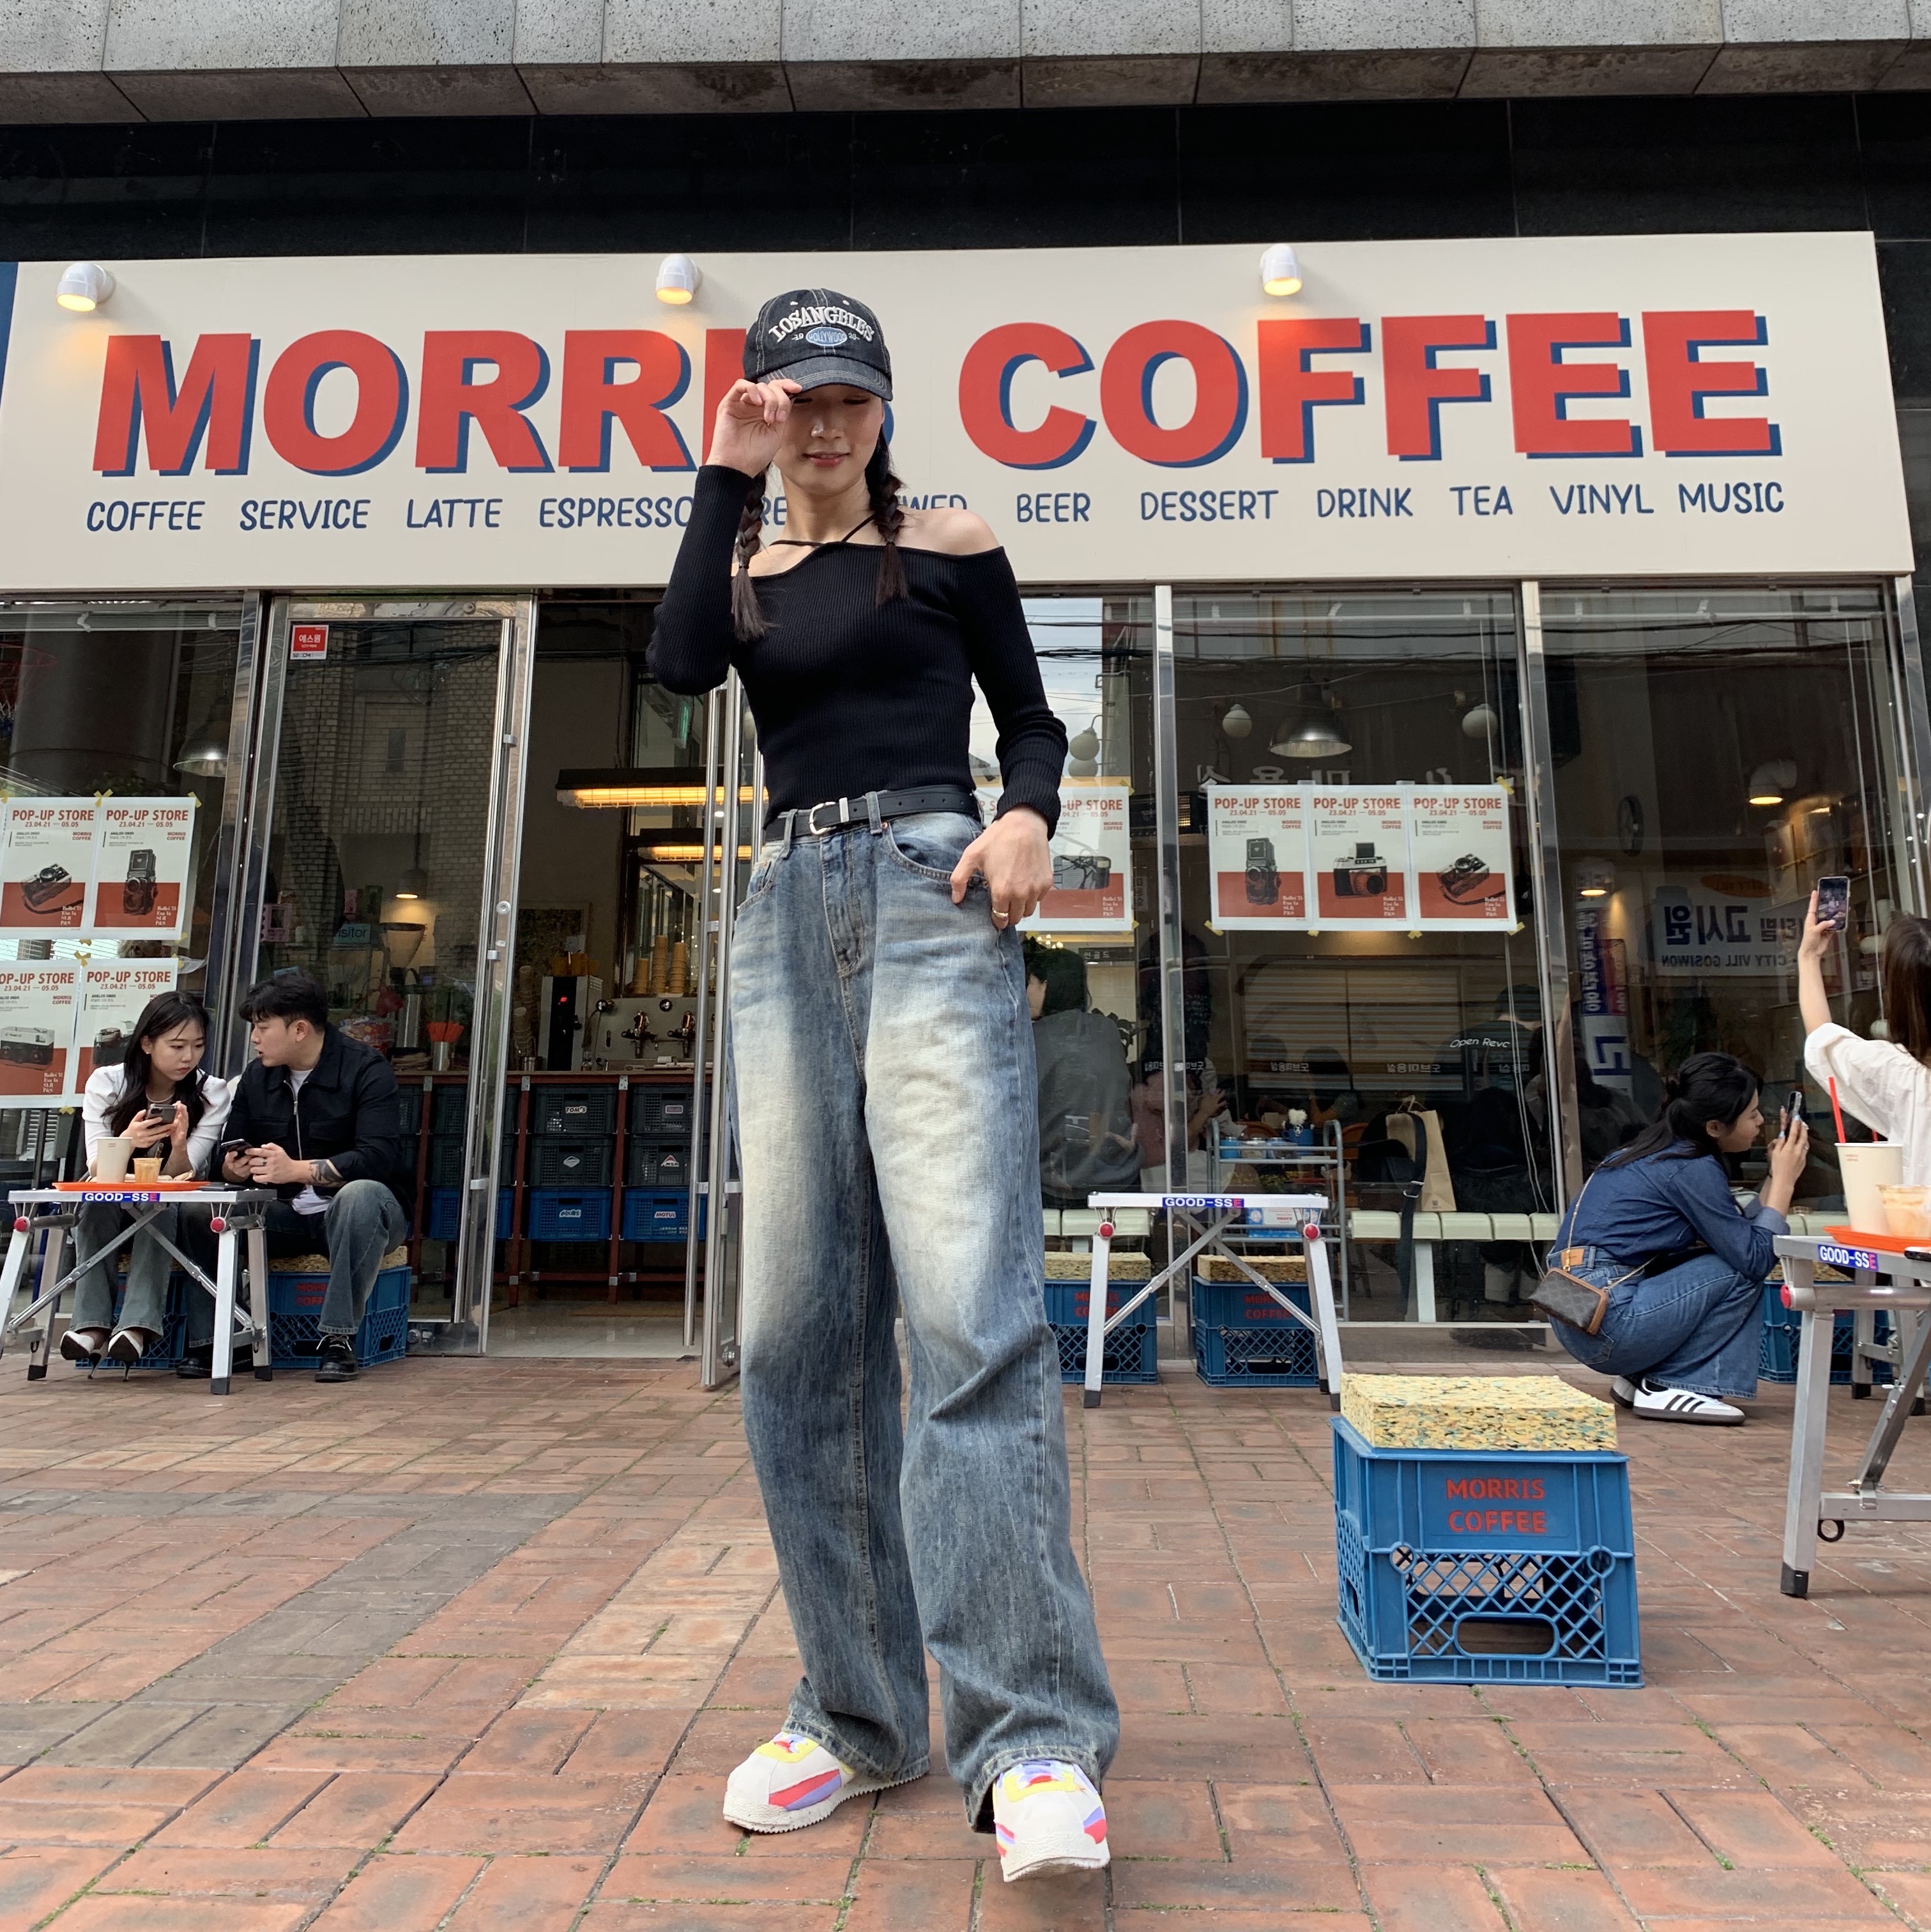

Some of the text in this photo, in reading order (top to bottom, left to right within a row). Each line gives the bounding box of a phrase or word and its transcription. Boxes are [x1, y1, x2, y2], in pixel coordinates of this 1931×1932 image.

[808, 331, 847, 344] HOLLYWOOD
[93, 310, 1783, 477] MORRI COFFEE
[86, 500, 205, 532] COFFEE
[240, 499, 370, 530] SERVICE
[406, 498, 503, 528] LATTE
[539, 495, 694, 528] ESPRESSO
[1016, 493, 1091, 523] BEER
[1141, 489, 1279, 521] DESSERT
[1317, 487, 1413, 518] DRINK
[1450, 485, 1513, 516] TEA
[1550, 484, 1654, 514] VINYL
[1679, 482, 1784, 513] MUSIC
[1062, 800, 1122, 810] -UP STORE
[1215, 798, 1301, 809] POP-UP STORE
[1314, 798, 1401, 809] POP-UP STORE
[1414, 798, 1501, 809] POP-UP STORE
[12, 810, 94, 820] POP-UP STORE
[106, 810, 188, 820] POP-UP STORE
[339, 927, 368, 939] isitor
[0, 973, 74, 984] OP-UP STORE
[87, 971, 171, 982] POP-UP STORE
[1449, 1038, 1479, 1048] Open
[85, 1193, 157, 1201] GOOD-SSE
[1165, 1198, 1242, 1207] GOOD-SSE
[1820, 1246, 1877, 1269] GOOD-SSE
[1446, 1477, 1545, 1500] MORRIS
[1448, 1509, 1546, 1533] COFFEE
